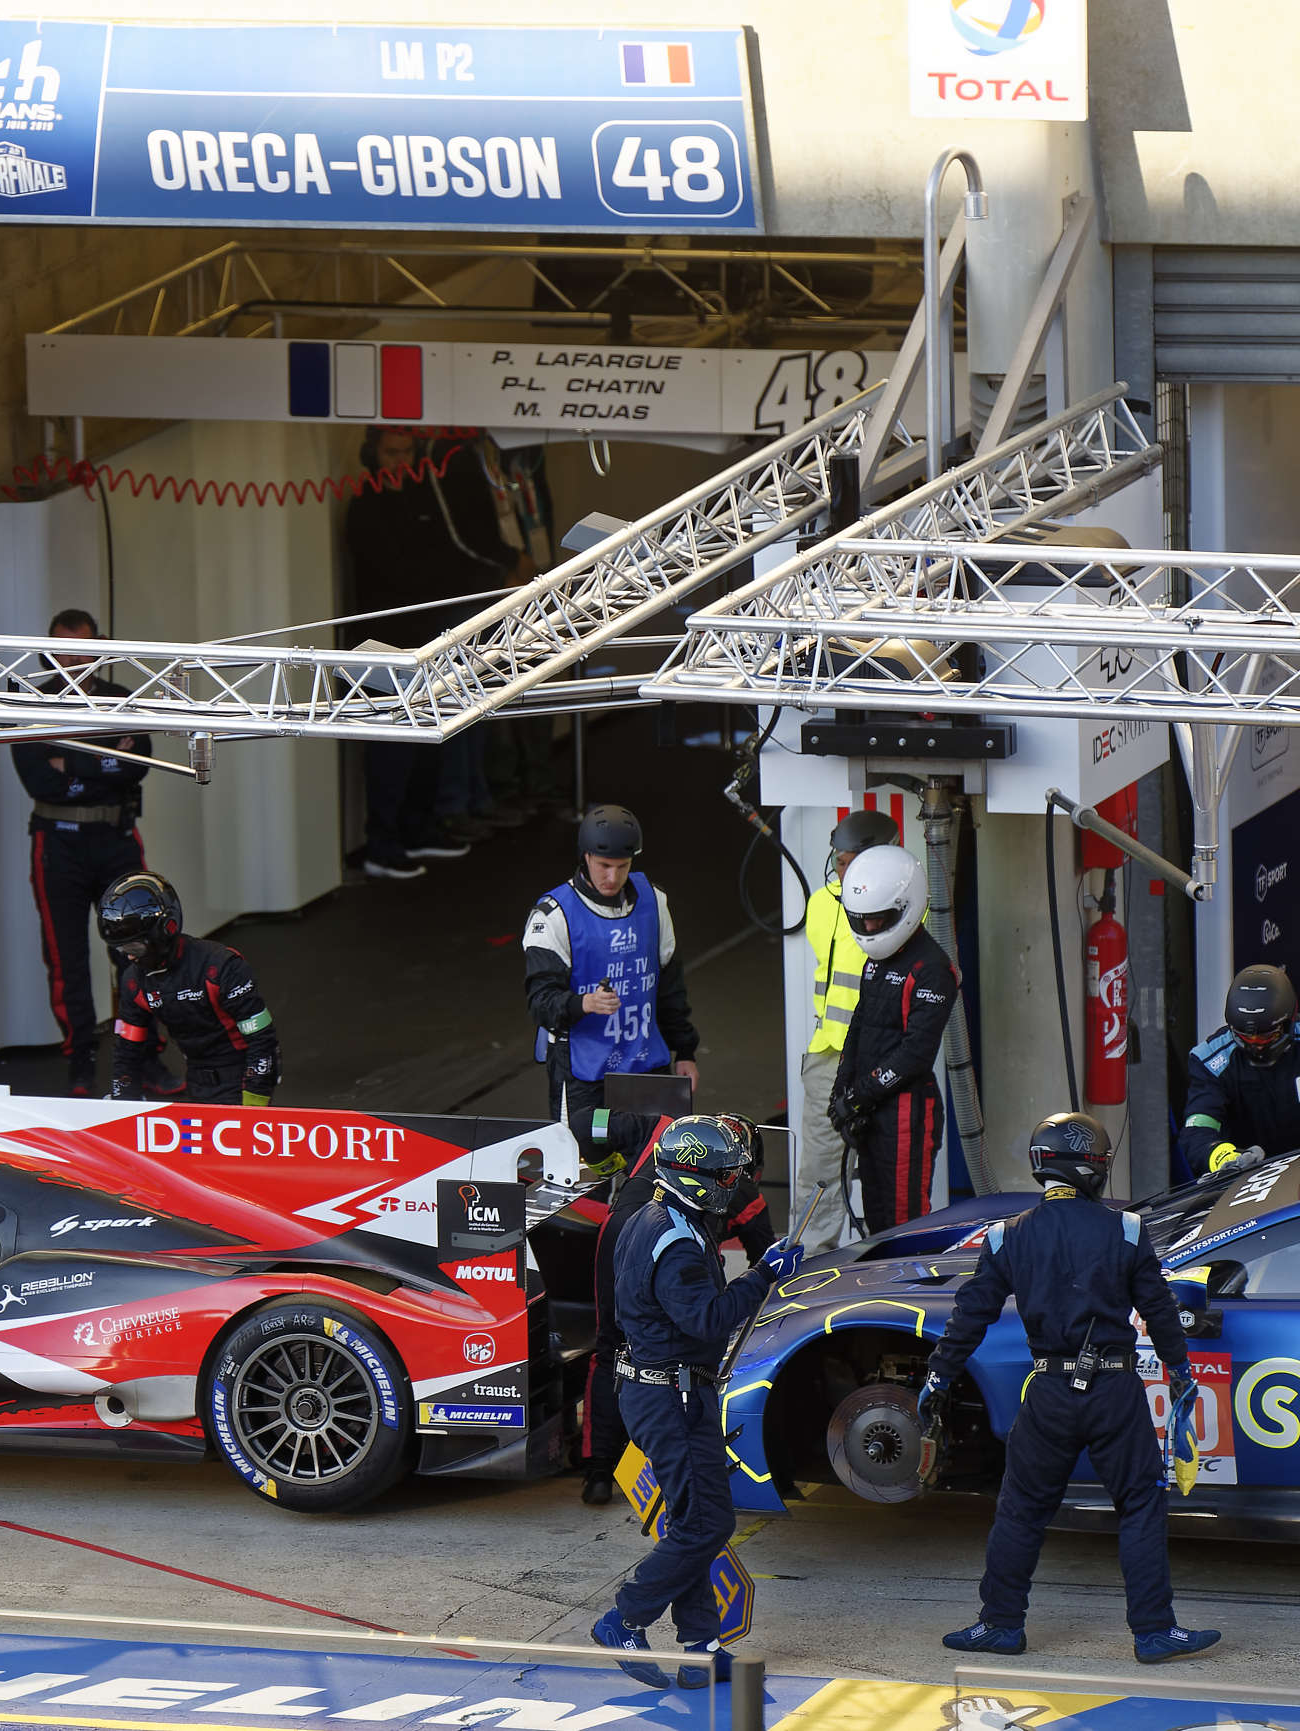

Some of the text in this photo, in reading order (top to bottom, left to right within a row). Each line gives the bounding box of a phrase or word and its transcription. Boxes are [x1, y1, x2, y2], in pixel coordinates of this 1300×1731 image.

[381, 41, 475, 82] LM P2
[928, 73, 1068, 102] TOTAL
[147, 128, 561, 199] ORECA-GIBSON
[611, 135, 725, 203] 48
[491, 350, 683, 371] P. LAFARGUE
[500, 376, 665, 395] P-L. CHATIN
[755, 350, 869, 437] 48
[513, 402, 650, 421] M. ROJAS
[606, 963, 624, 978] RH
[635, 957, 648, 974] TV
[136, 1115, 405, 1162] IDEC SPORT
[79, 1217, 158, 1232] spark
[467, 1206, 501, 1222] ICM
[1166, 1219, 1258, 1265] www.TFSPORT.co.uk
[20, 1271, 93, 1292] REBELLION
[455, 1265, 516, 1282] MOTUL
[99, 1307, 180, 1335] CHEVREUSE
[102, 1321, 183, 1345] COURTAGE
[349, 1339, 397, 1422] MICHELIN
[449, 1411, 513, 1421] MICHELIN
[214, 1388, 254, 1475] MICHELIN
